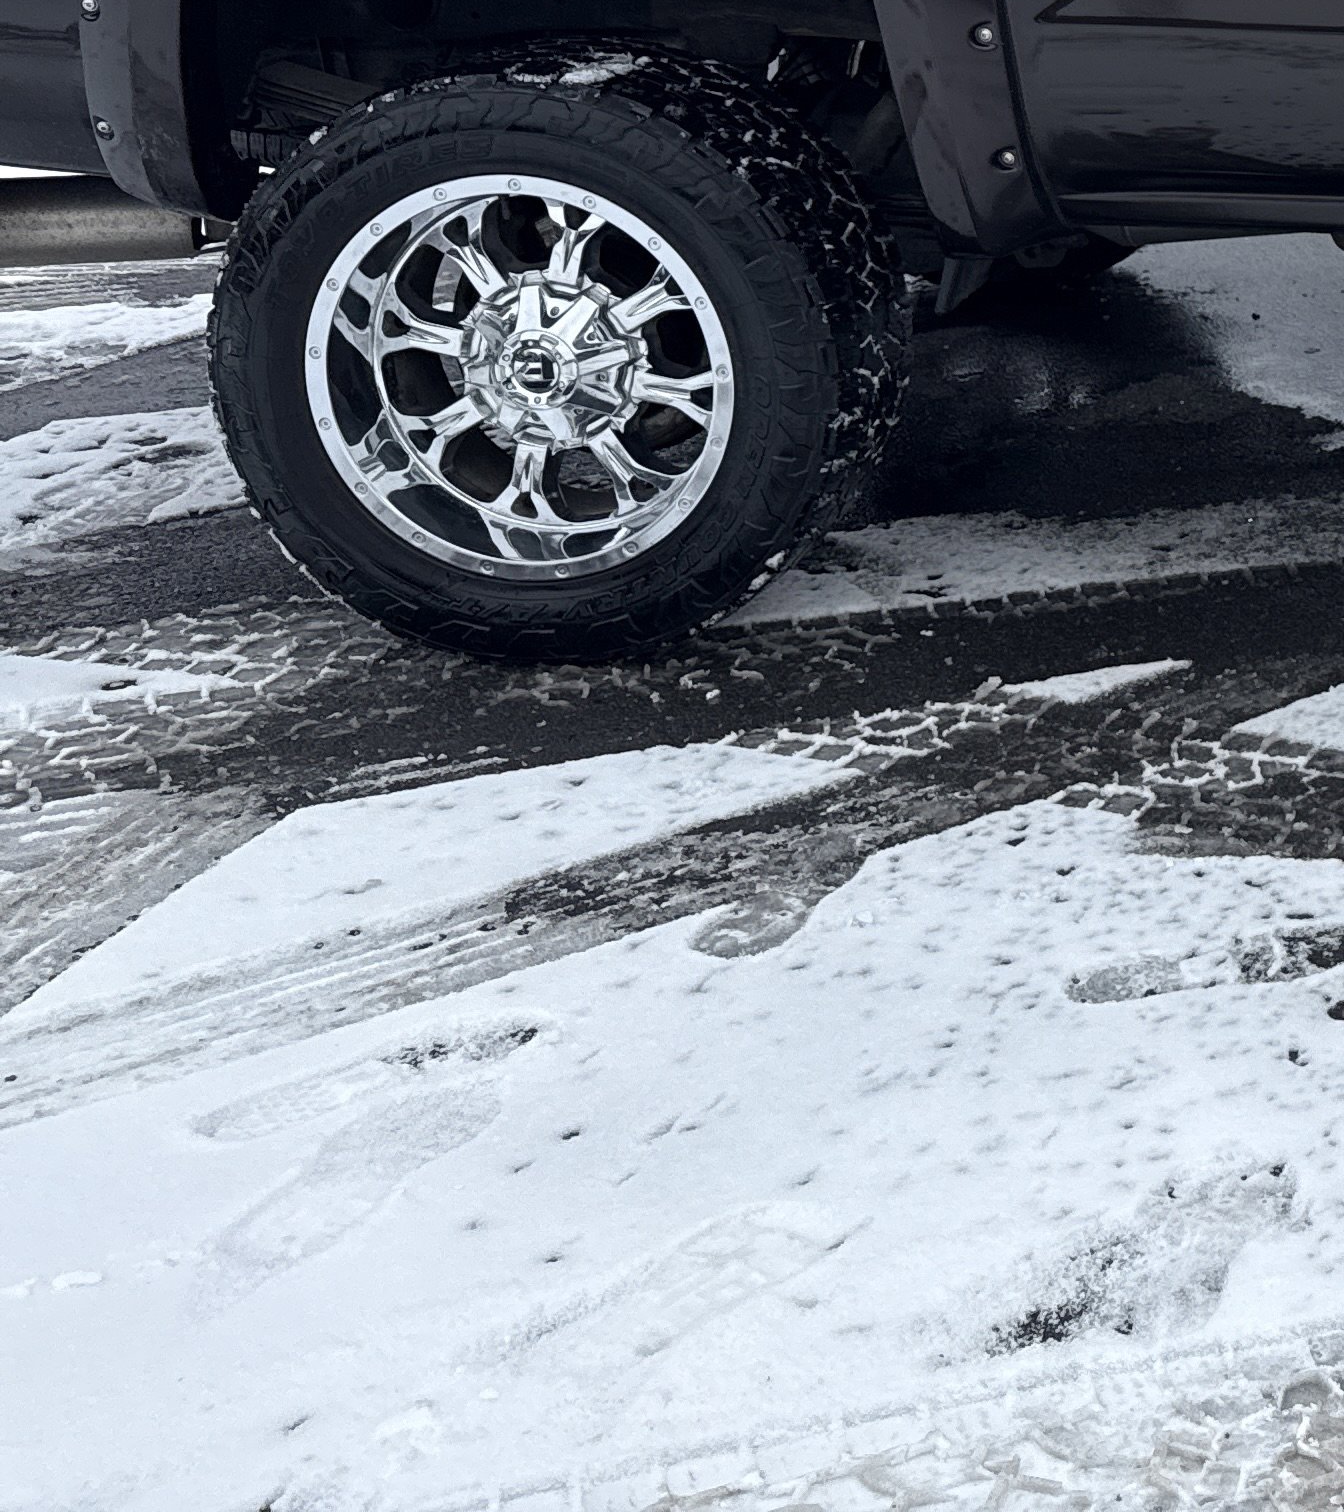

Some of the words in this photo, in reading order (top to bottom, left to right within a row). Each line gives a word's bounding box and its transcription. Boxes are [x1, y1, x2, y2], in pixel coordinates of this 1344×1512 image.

[346, 133, 494, 200] TIRES
[734, 374, 773, 500] OPEN
[564, 499, 739, 620] COUNTRY
